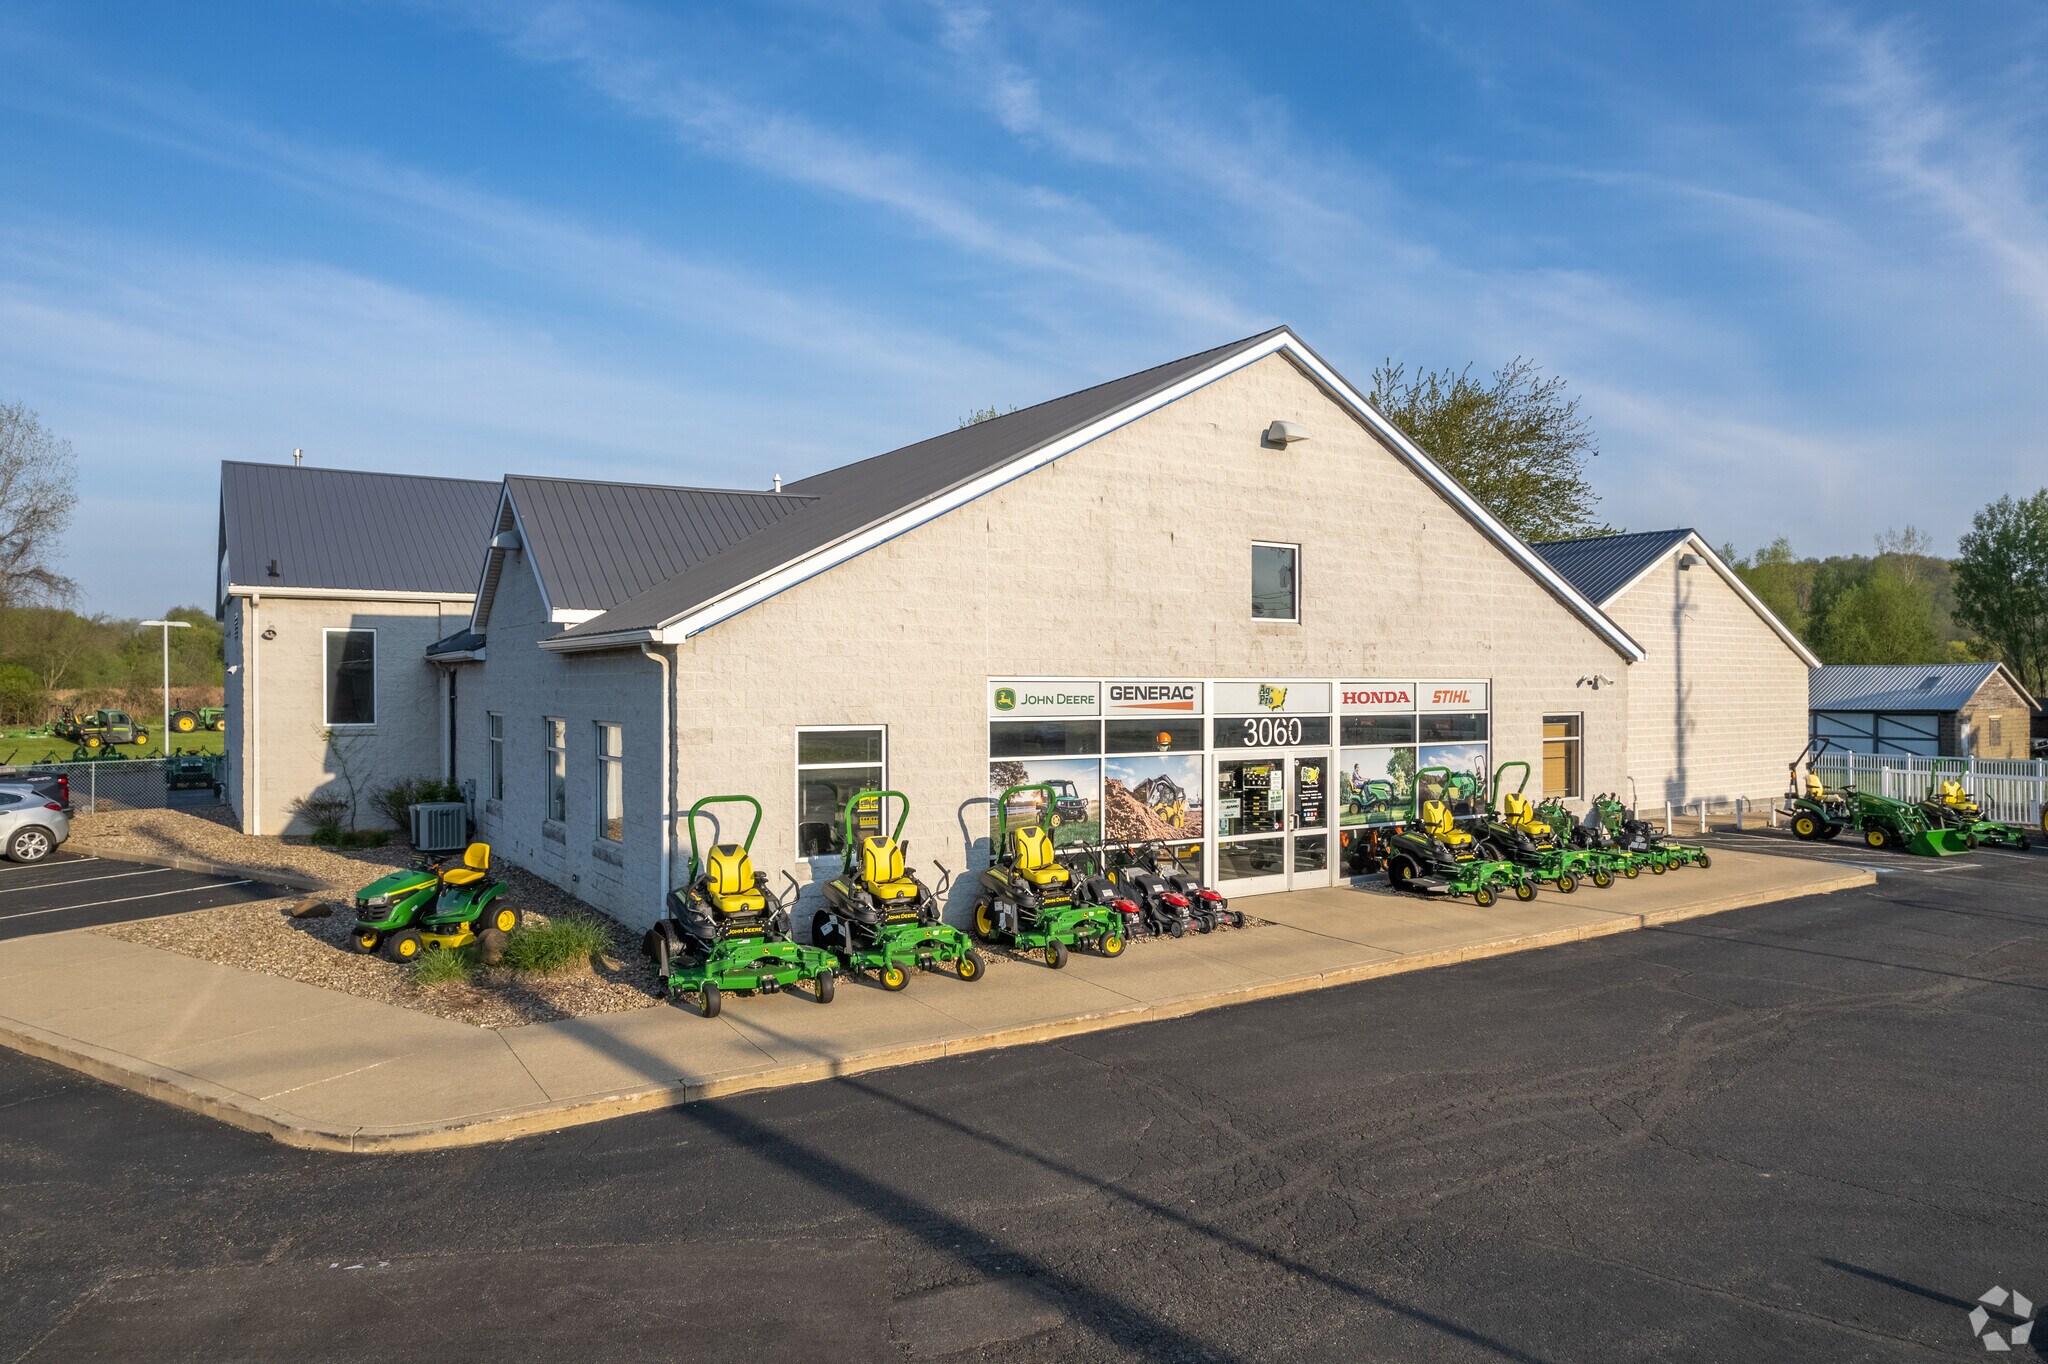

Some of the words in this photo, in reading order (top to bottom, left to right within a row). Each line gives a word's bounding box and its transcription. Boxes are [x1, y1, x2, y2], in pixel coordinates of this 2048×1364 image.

[1020, 693, 1054, 705] JOHN
[1056, 693, 1095, 705] DEERE
[1109, 685, 1194, 701] GENERAC
[1259, 695, 1274, 705] Pro
[1342, 691, 1411, 705] HONDA
[1432, 690, 1471, 704] STIHL
[1243, 717, 1302, 747] 3060
